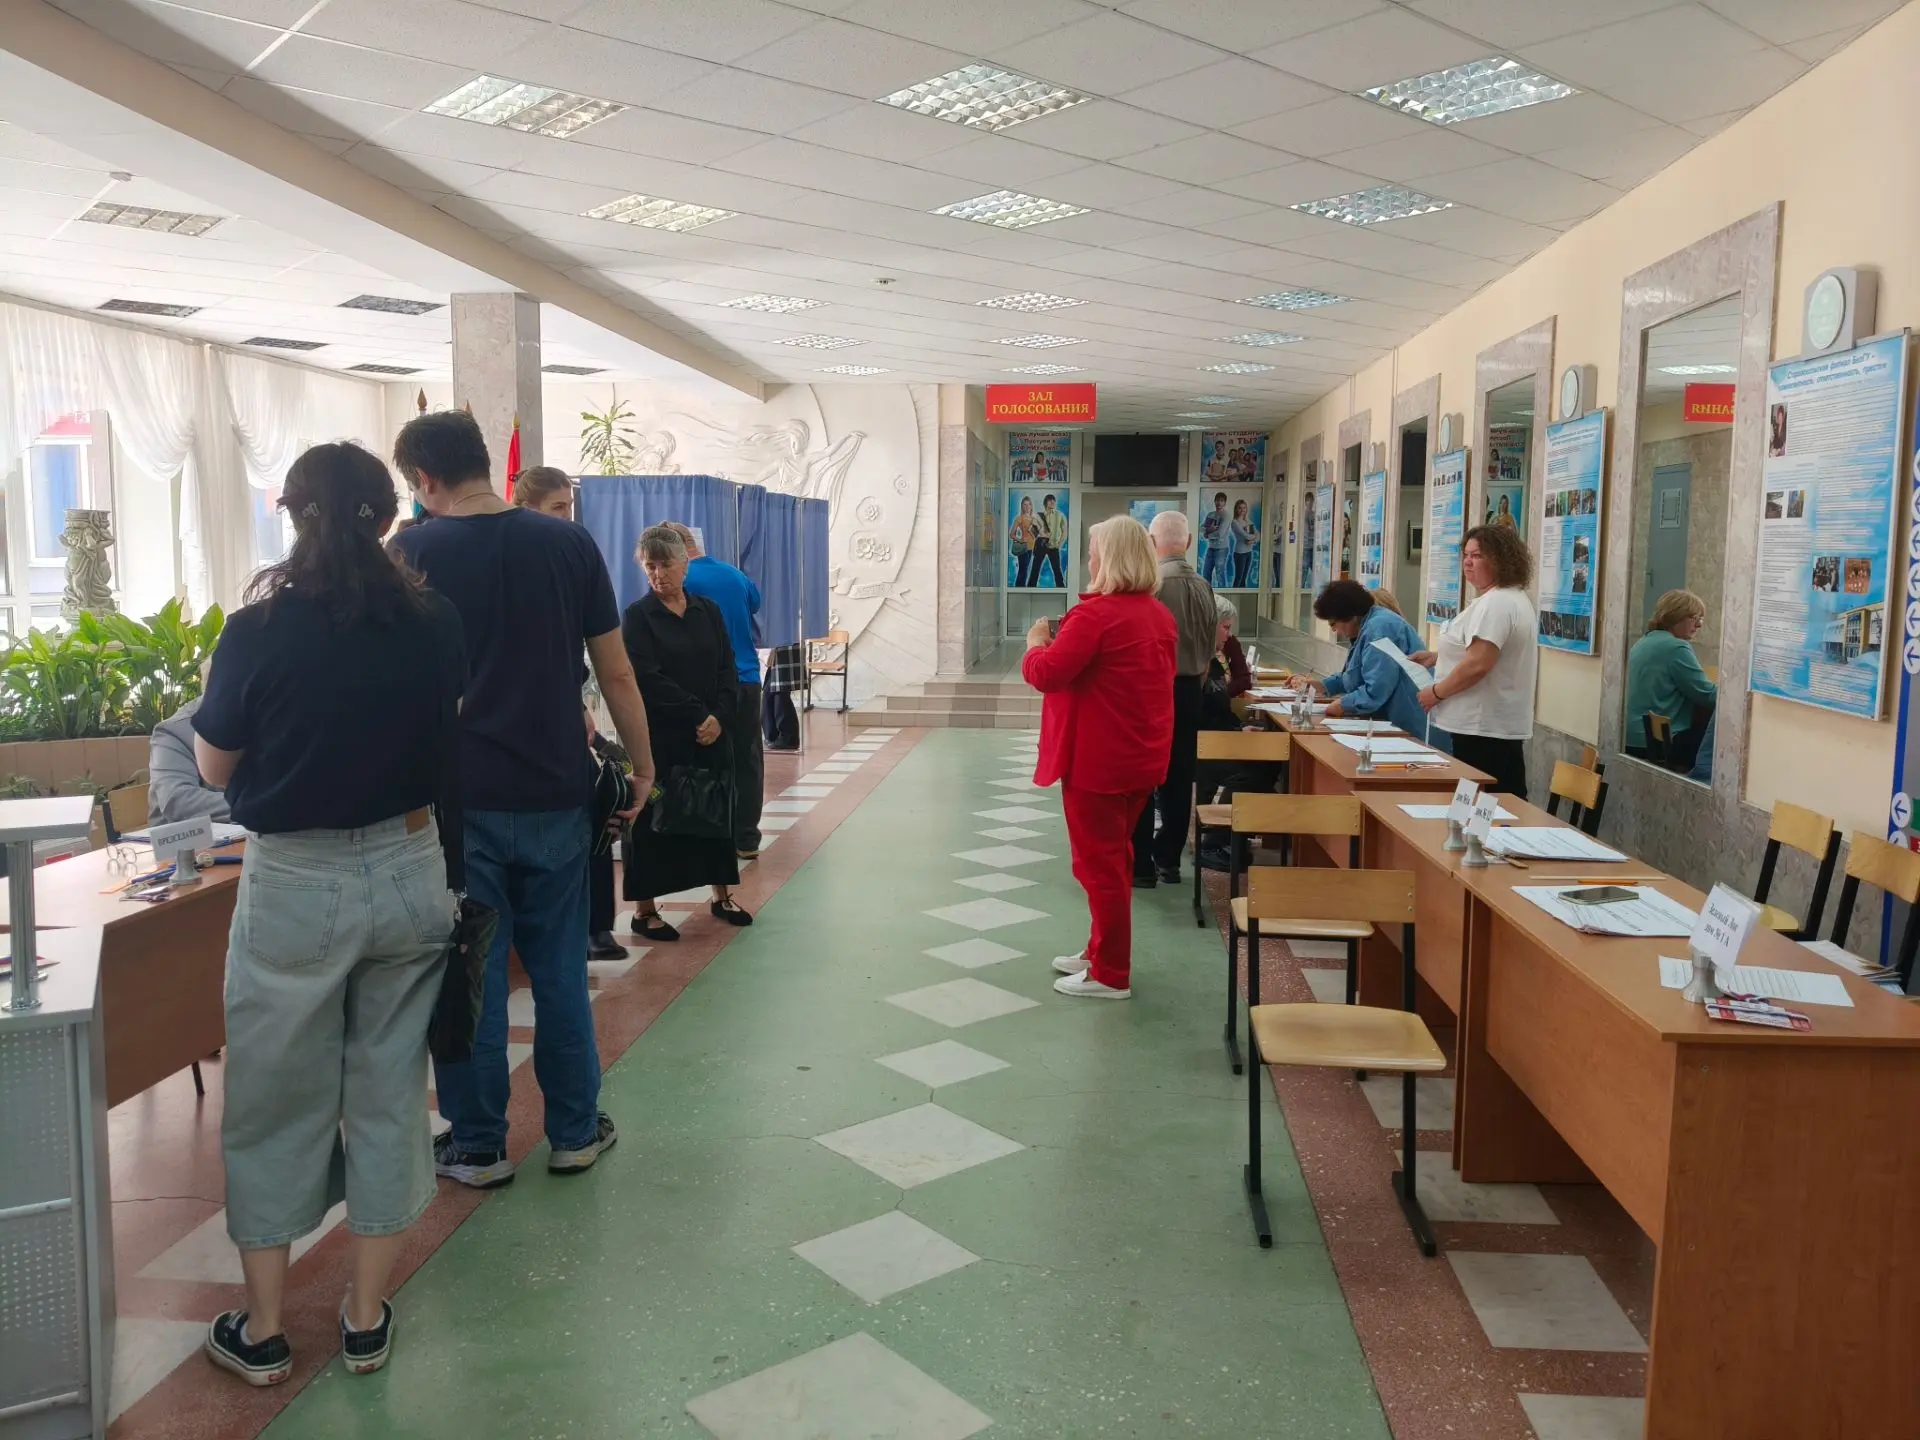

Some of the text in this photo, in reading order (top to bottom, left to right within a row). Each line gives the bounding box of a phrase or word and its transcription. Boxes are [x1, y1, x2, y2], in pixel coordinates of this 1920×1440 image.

[1028, 391, 1053, 401] ЗАЛ
[992, 403, 1089, 414] ГОЛОСОВАНИЯ
[1236, 437, 1257, 445] ТЫ?
